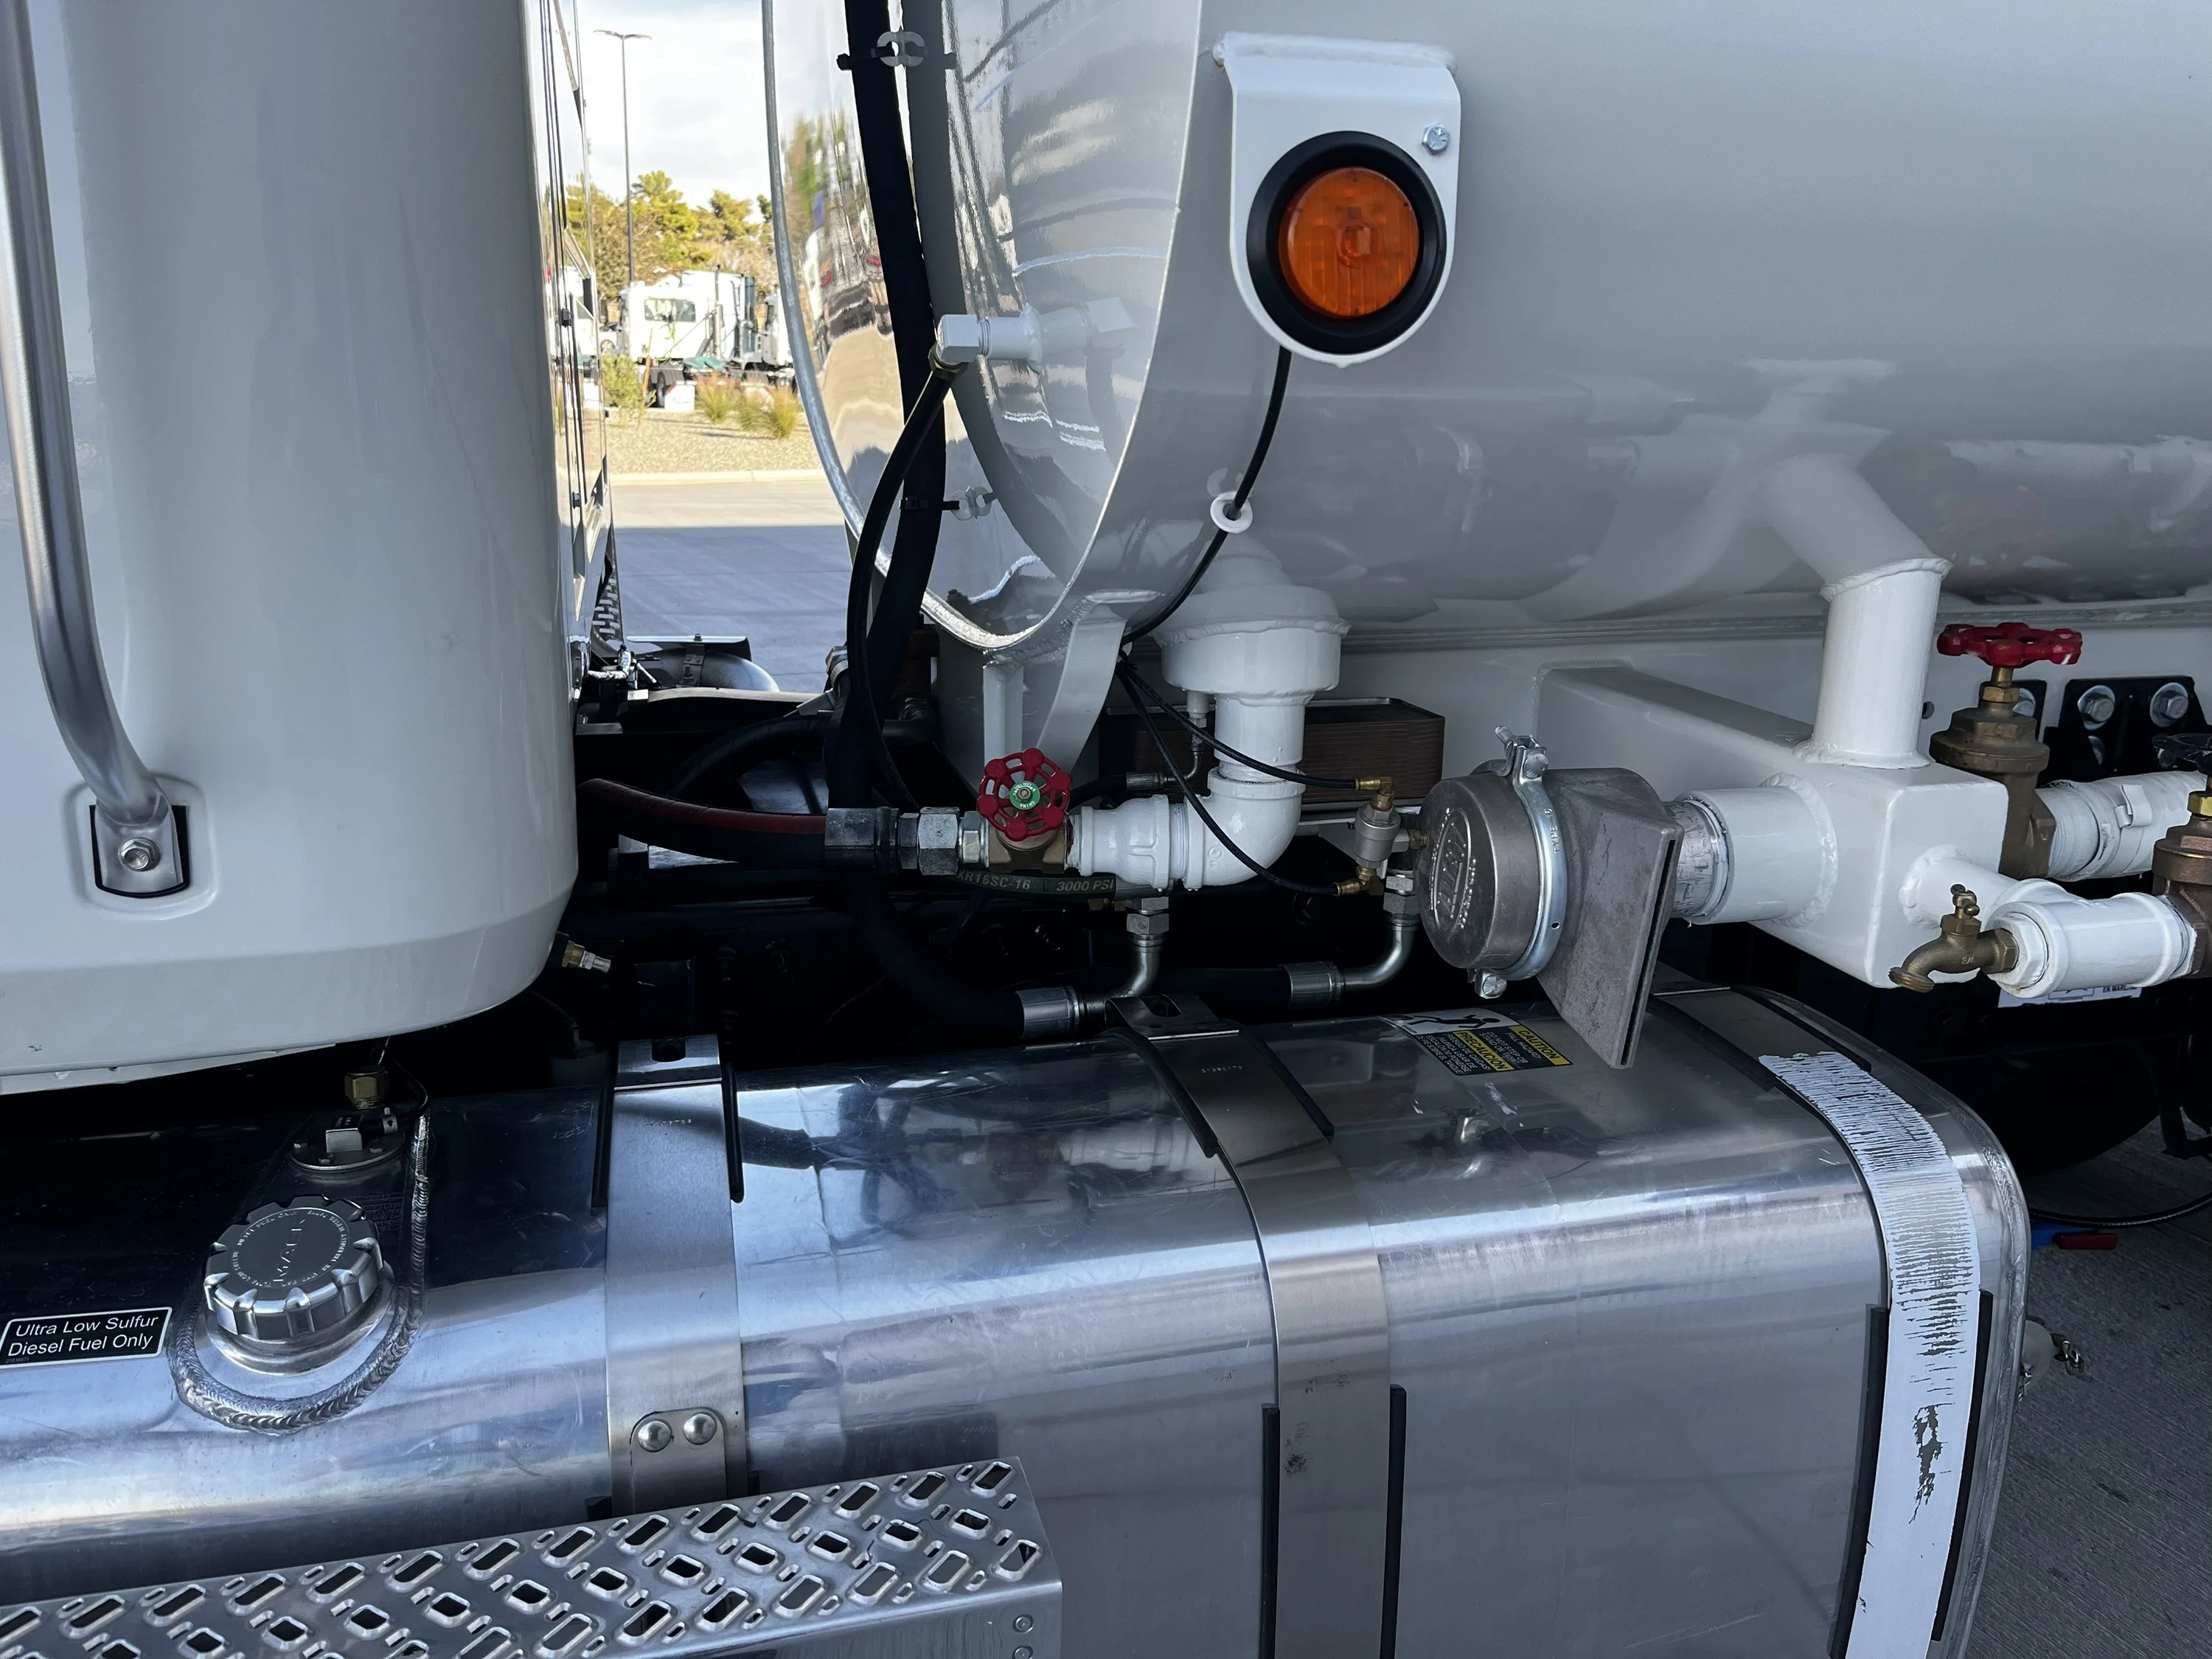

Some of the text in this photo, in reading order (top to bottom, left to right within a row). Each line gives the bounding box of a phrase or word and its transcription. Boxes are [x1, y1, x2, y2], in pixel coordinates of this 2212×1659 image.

[1548, 825, 1562, 854] TYPE
[1056, 880, 1090, 891] 3000
[1092, 878, 1115, 891] PSI
[1495, 1037, 1509, 1046] NOT
[1504, 1045, 1520, 1057] STEP
[1519, 1030, 1560, 1059] CAUTION
[15, 1315, 159, 1337] Ultra Low Sulfur
[8, 1333, 153, 1357] Diesel Fuel Only
